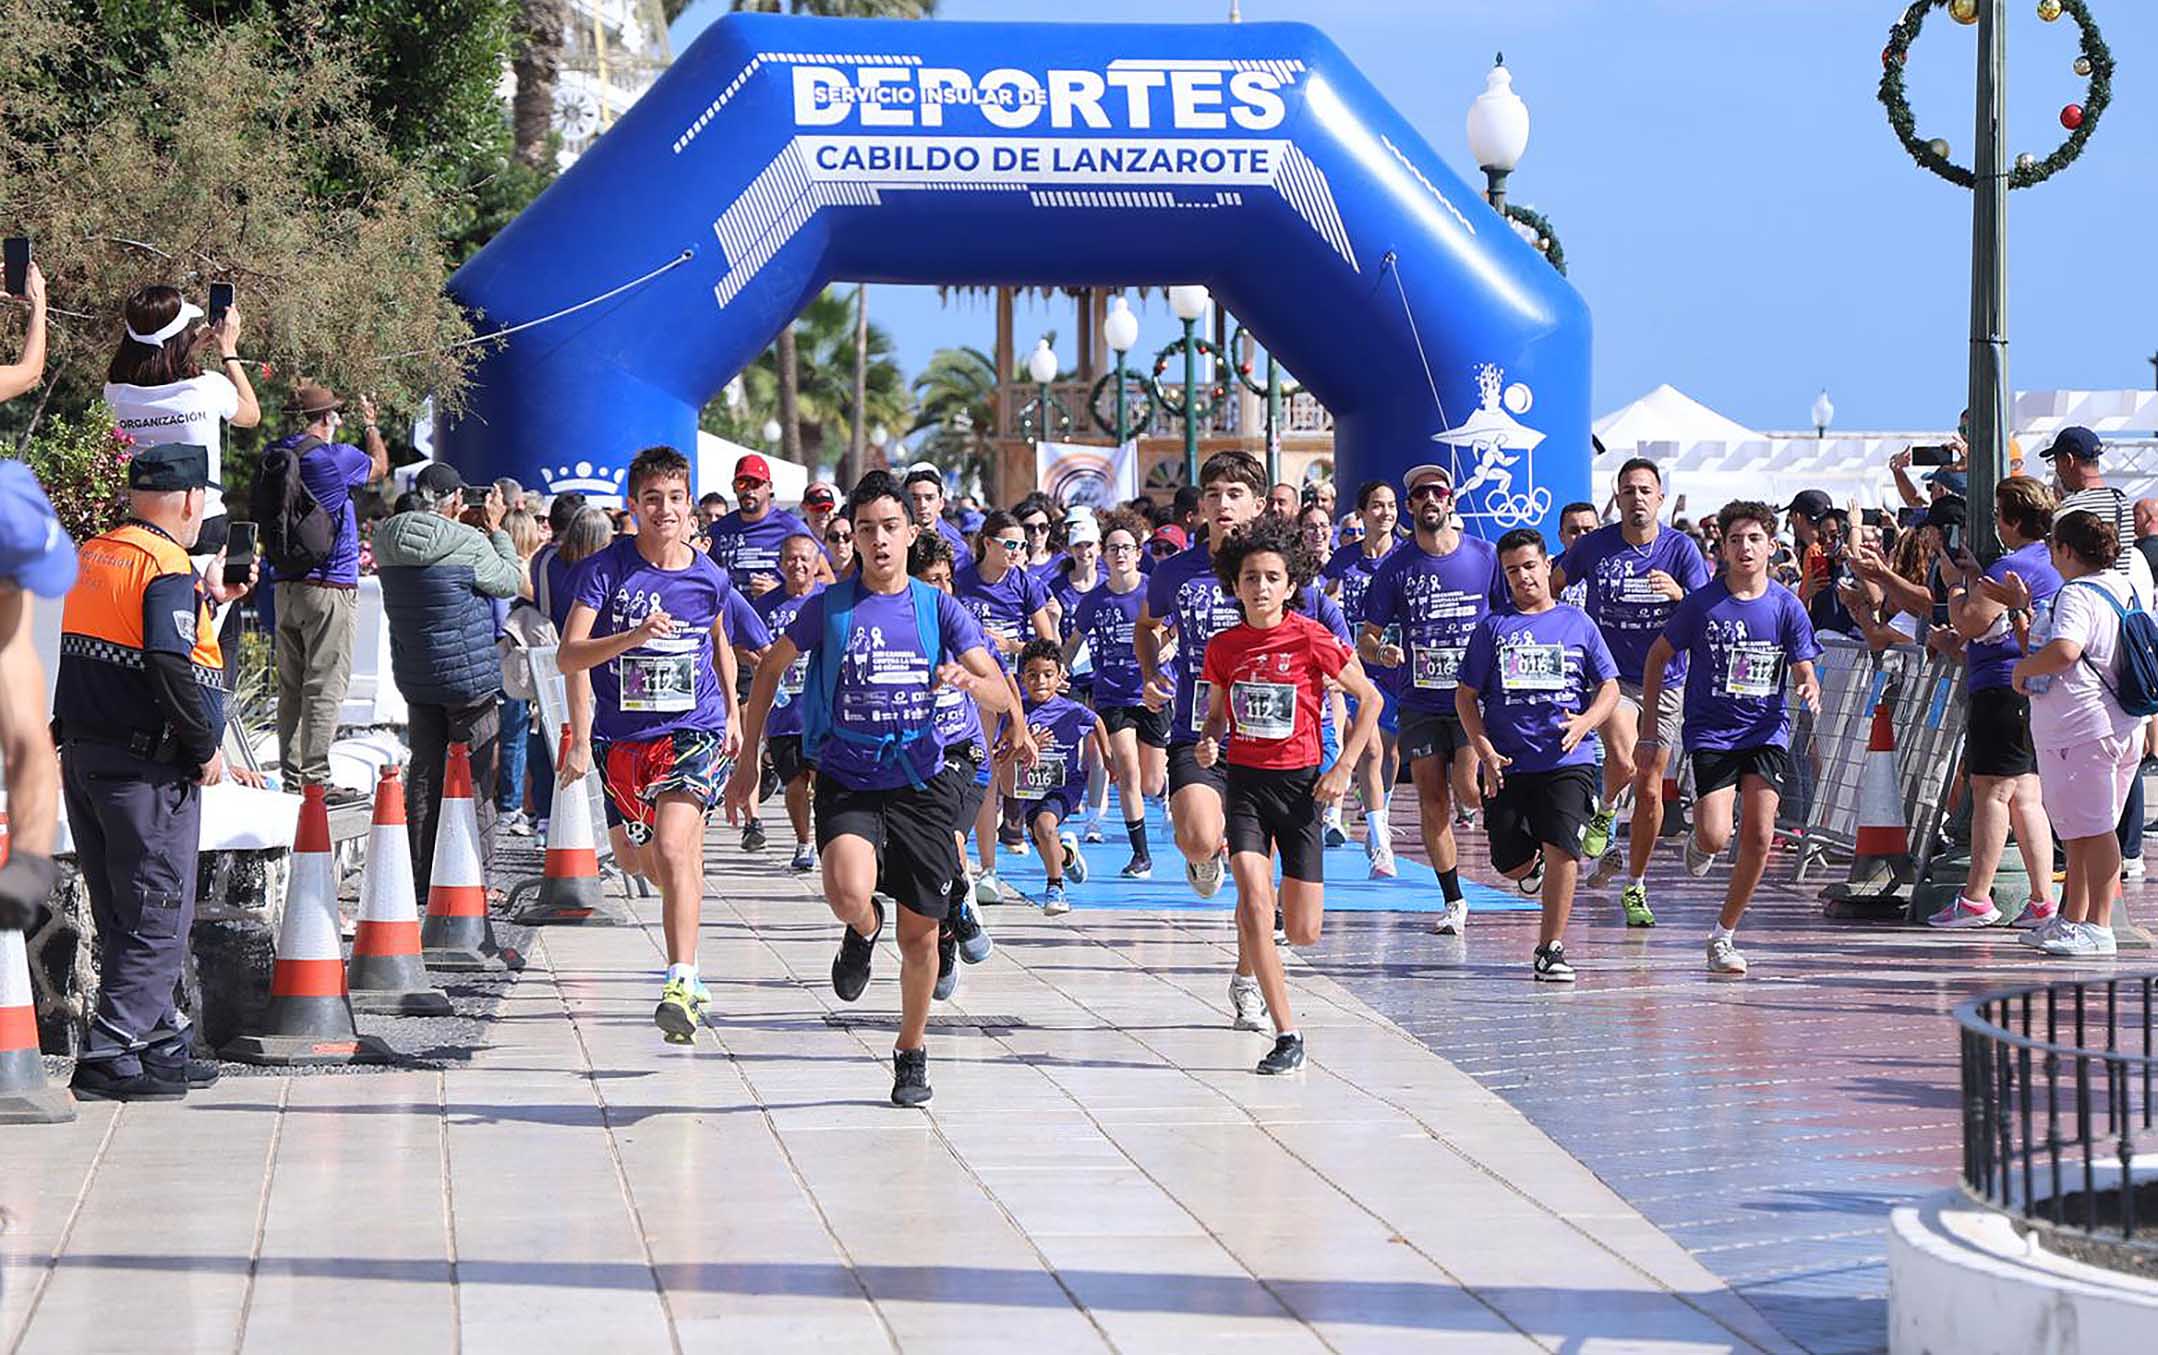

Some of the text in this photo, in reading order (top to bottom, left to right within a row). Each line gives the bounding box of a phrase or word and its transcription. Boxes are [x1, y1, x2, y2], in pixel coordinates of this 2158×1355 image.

[791, 65, 1286, 131] DEPORTES
[814, 86, 1047, 106] SERVICIO INSULAR DE
[816, 145, 1269, 173] CABILDO DE LANZAROTE
[119, 410, 206, 430] ORGANIZACIÓN
[1245, 700, 1273, 719] 112
[1026, 770, 1052, 786] 016
